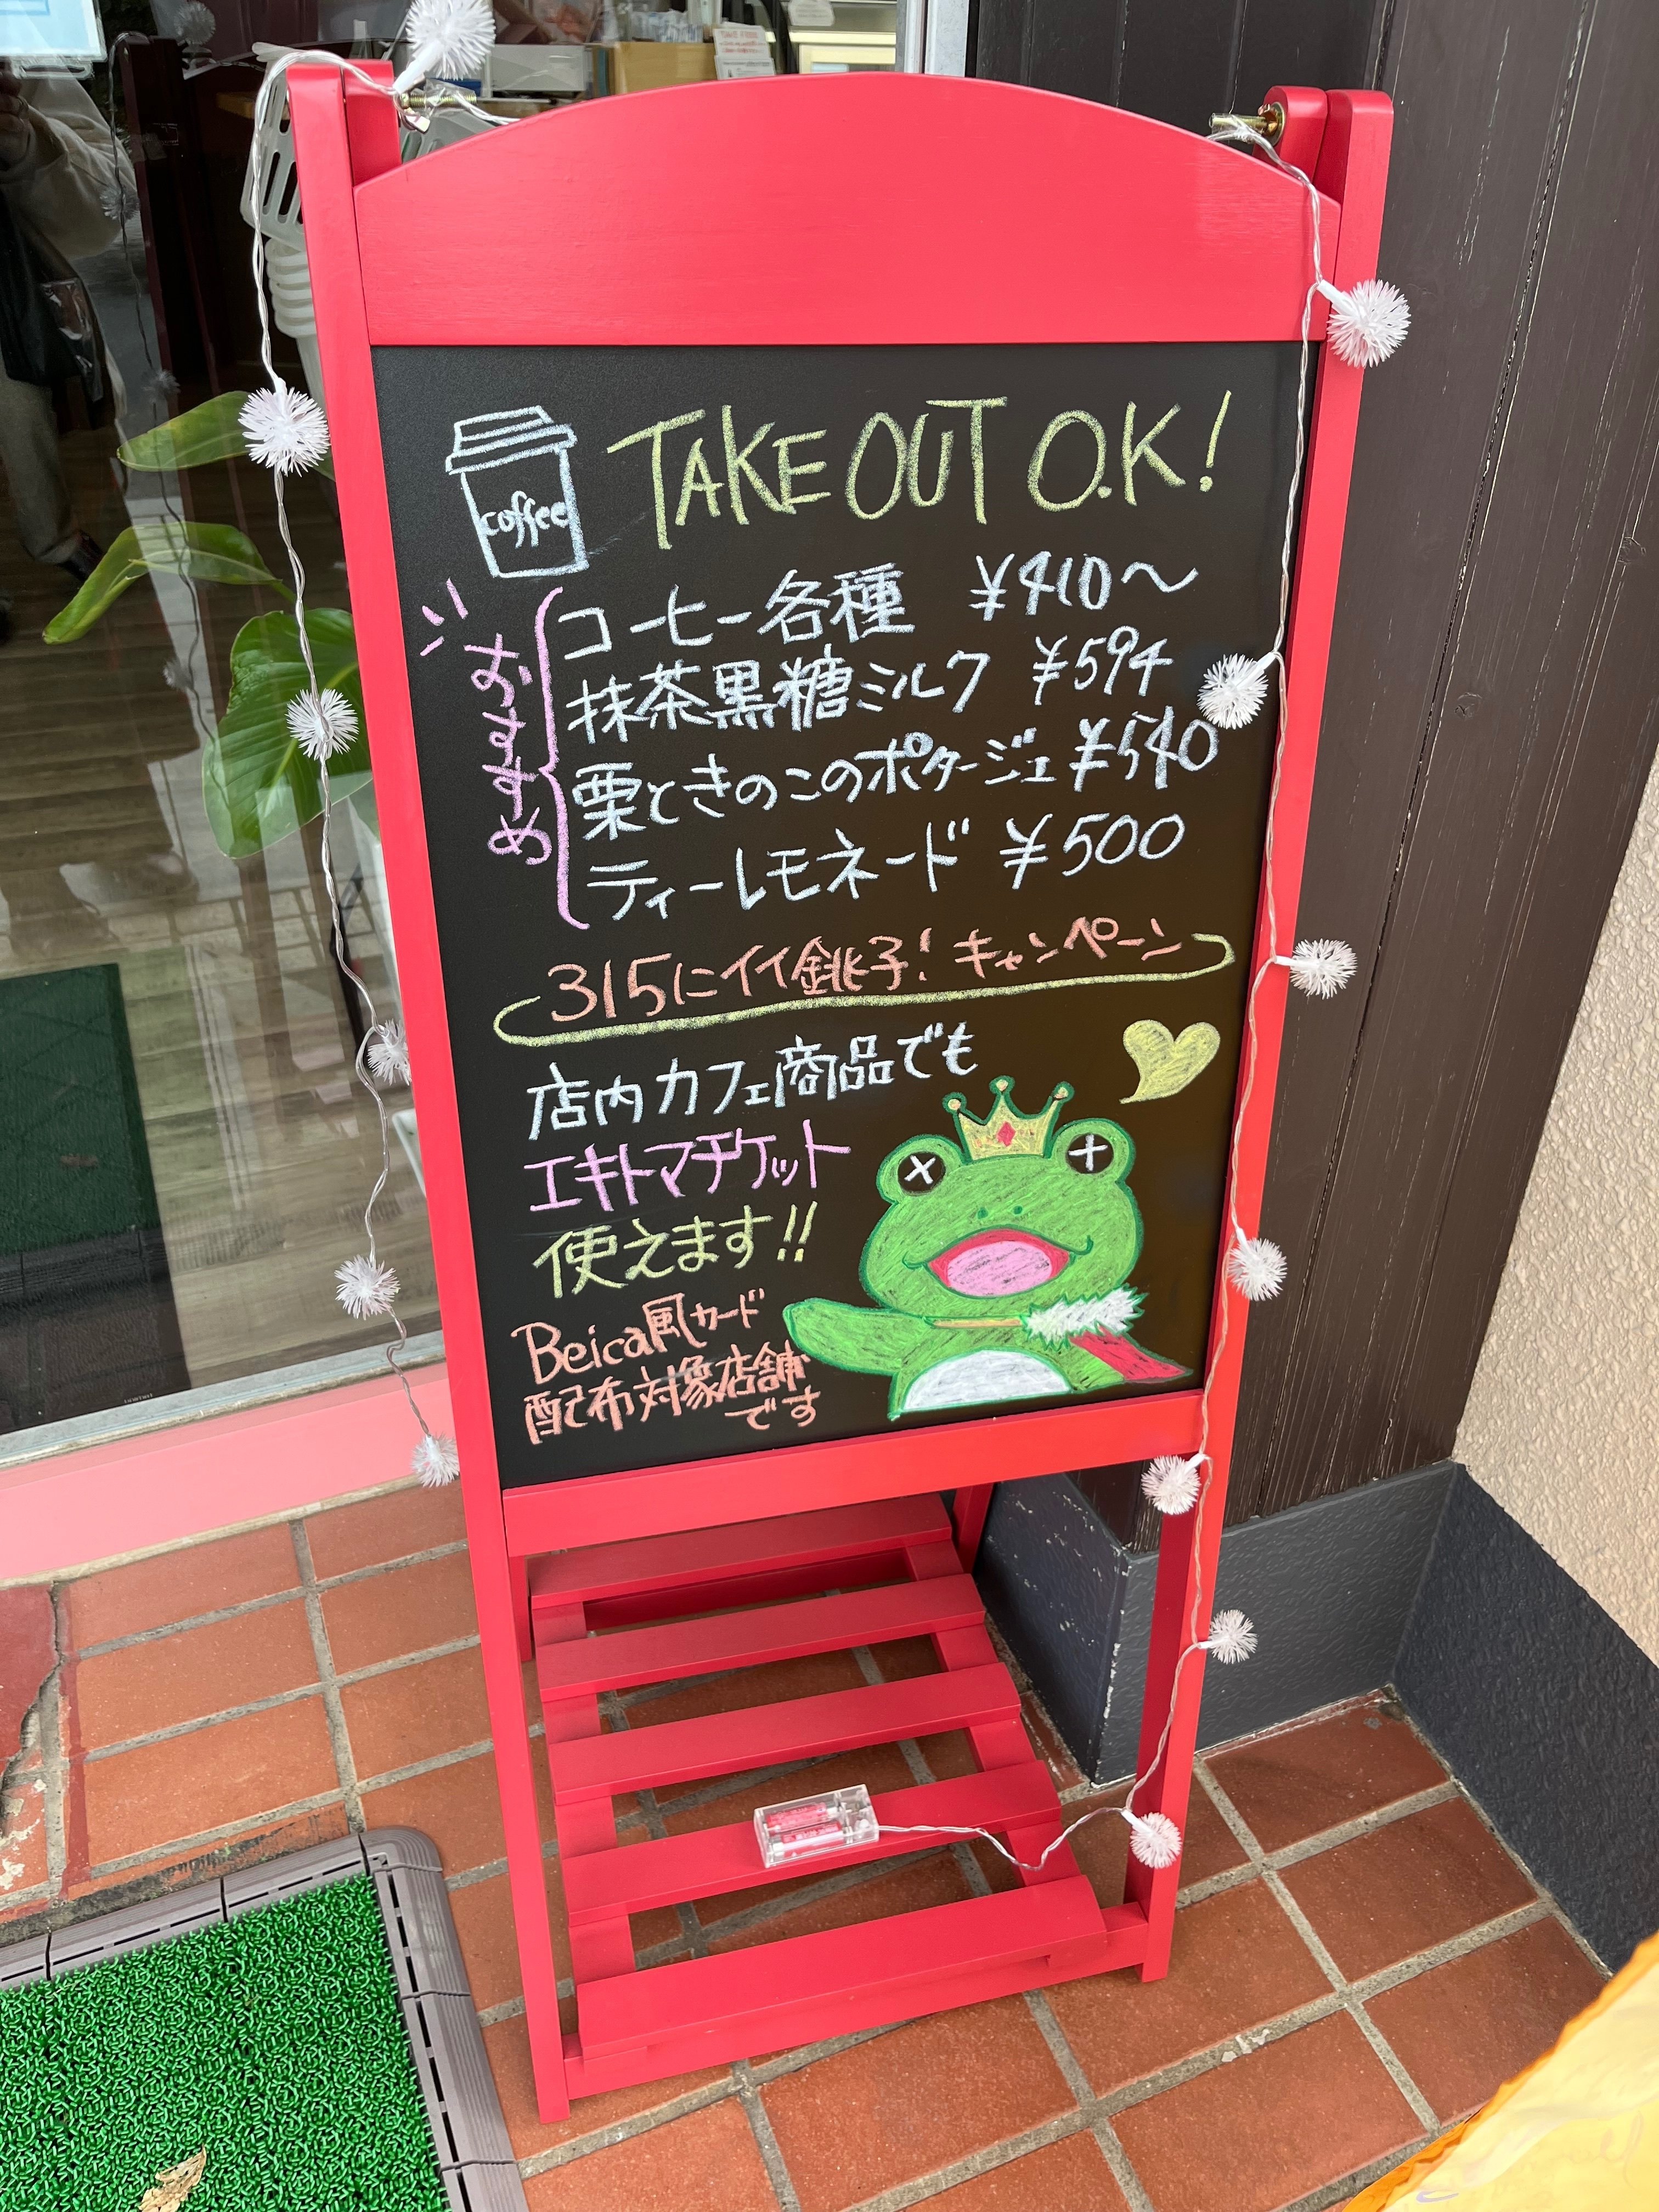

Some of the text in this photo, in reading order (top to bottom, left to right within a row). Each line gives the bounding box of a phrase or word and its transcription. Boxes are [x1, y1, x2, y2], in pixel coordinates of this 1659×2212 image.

[481, 491, 569, 549] coffee
[607, 404, 831, 550] TAKE
[845, 396, 1008, 525] OUT
[557, 562, 916, 661] コーヒー各種
[1032, 625, 1175, 706] ¥594
[464, 633, 552, 866] おすすめ
[1070, 706, 1219, 793] ¥540
[586, 812, 1185, 921] ティーレモネード ¥500
[523, 1339, 811, 1446] 配布対象店舗
[724, 1385, 821, 1430] です
